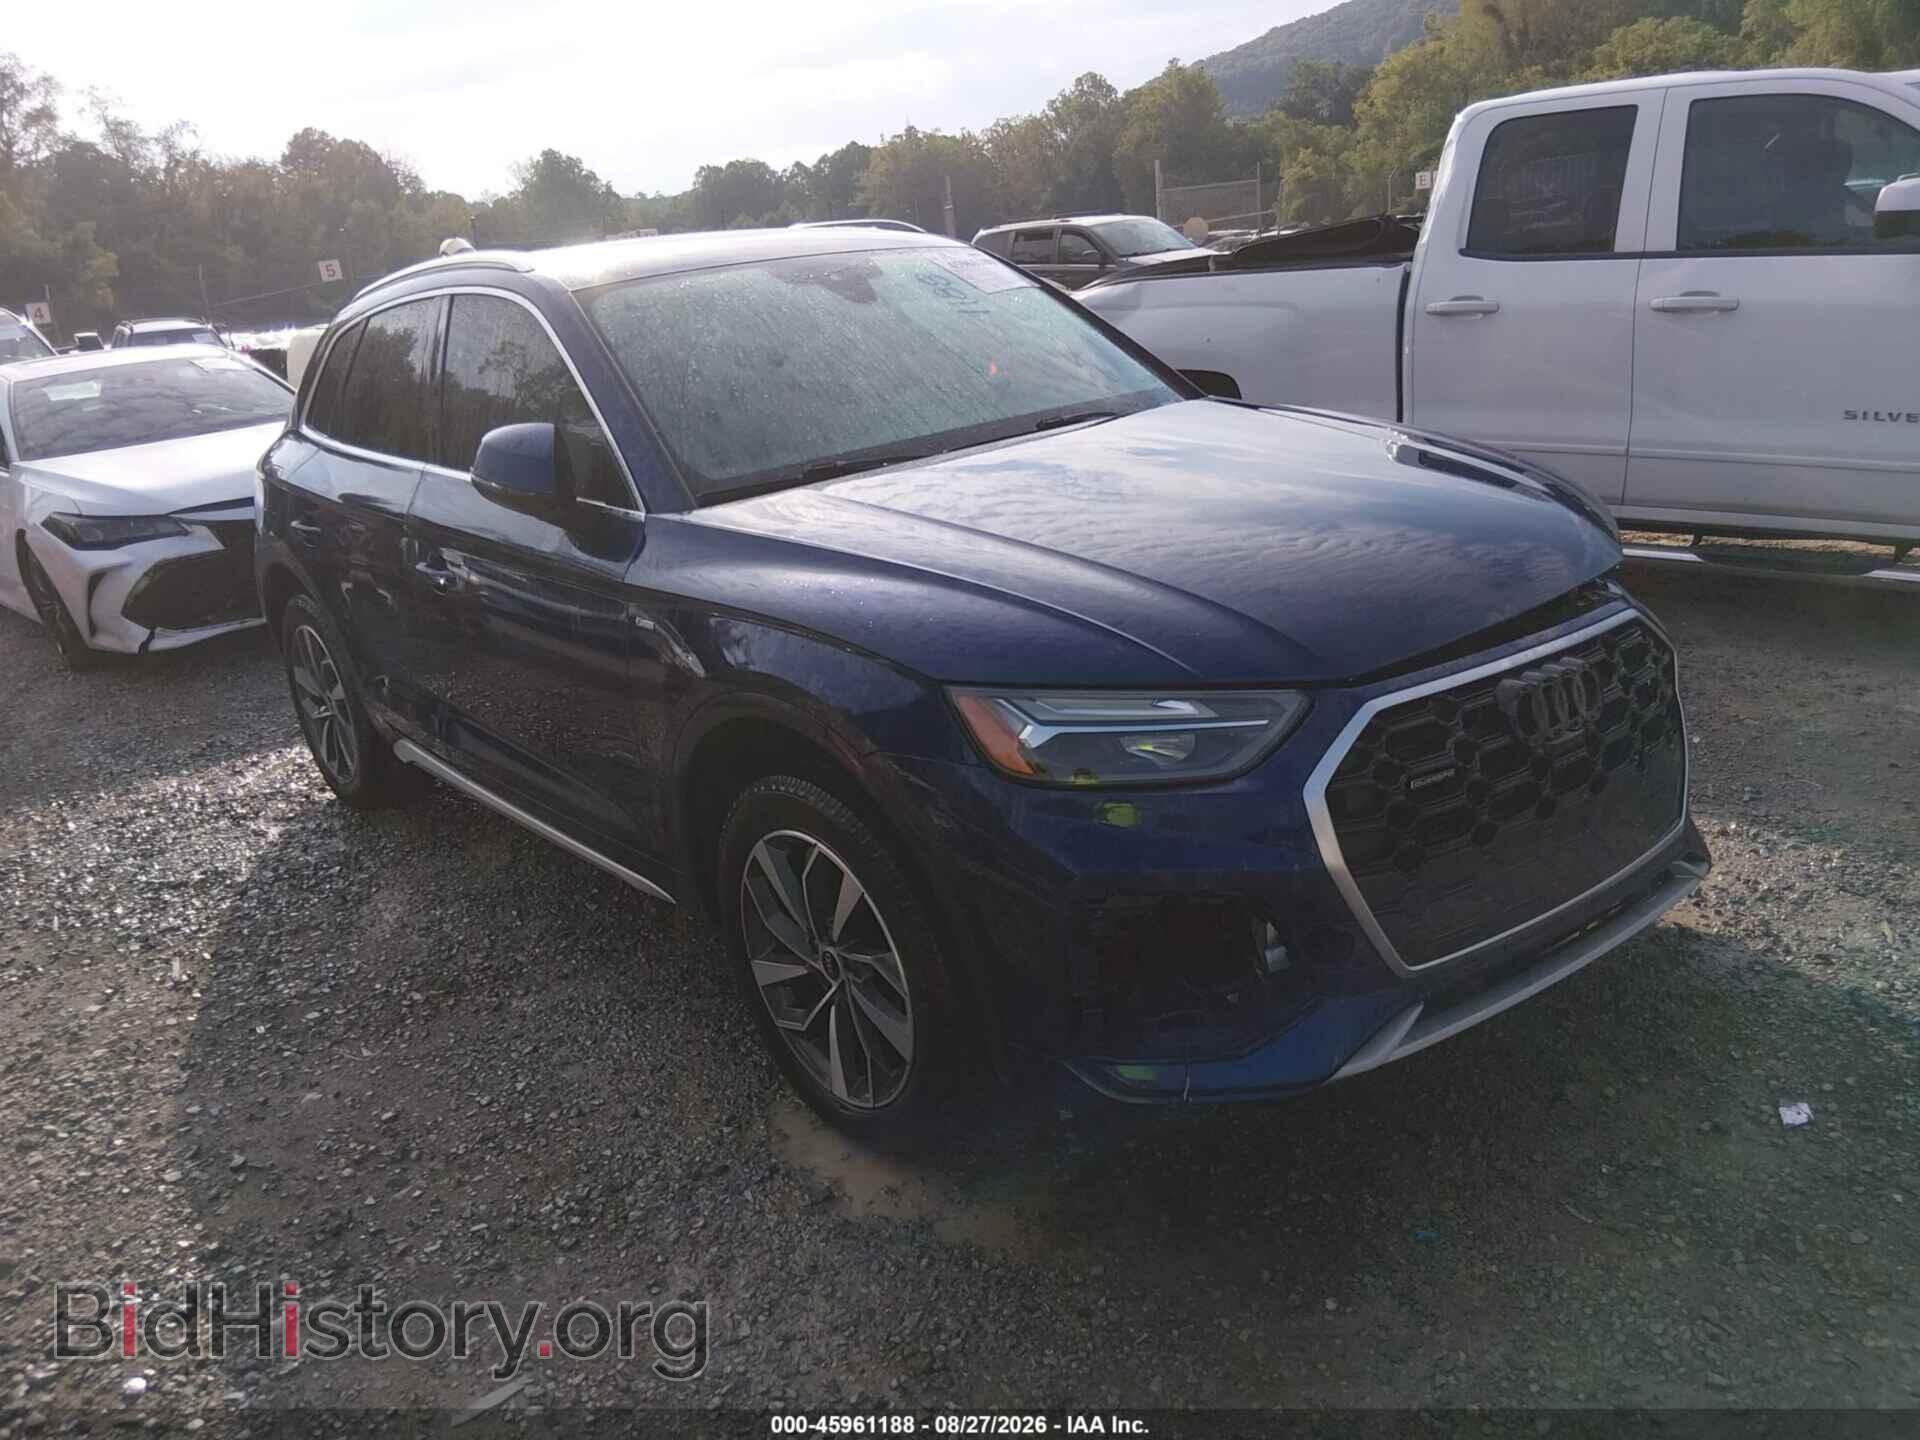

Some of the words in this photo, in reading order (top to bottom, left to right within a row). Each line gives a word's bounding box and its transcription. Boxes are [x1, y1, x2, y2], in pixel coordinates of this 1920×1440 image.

[324, 263, 337, 278] 5
[34, 306, 45, 320] 4
[1843, 409, 1920, 424] SILVE
